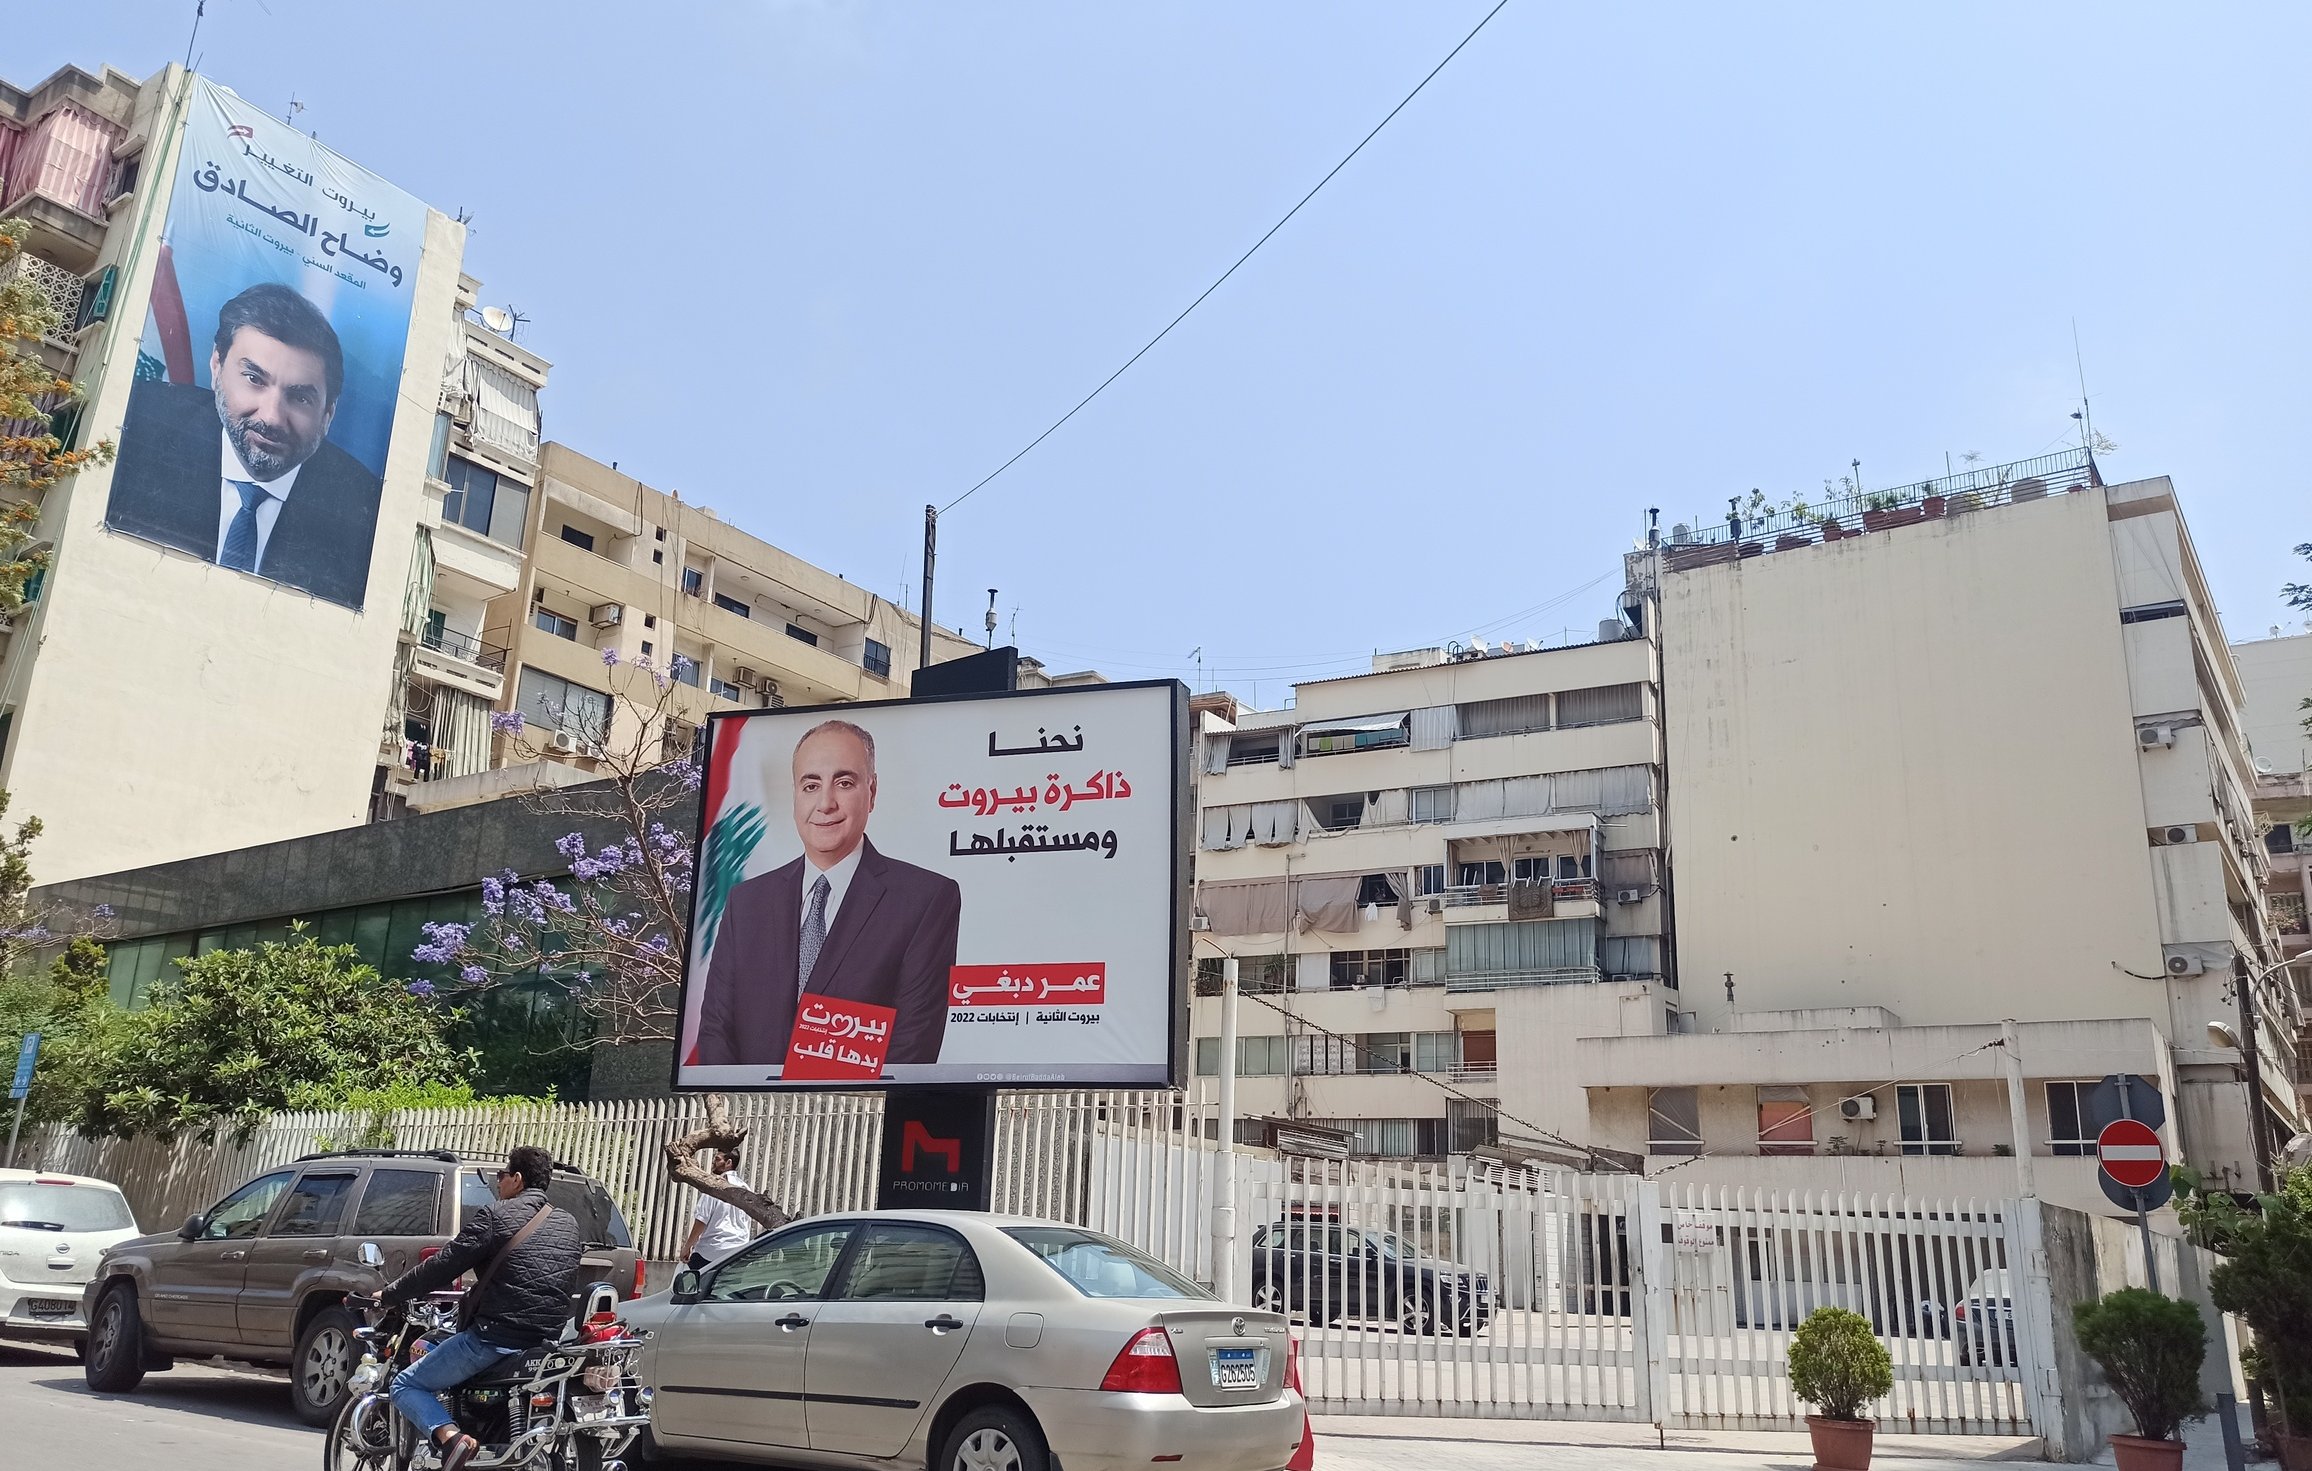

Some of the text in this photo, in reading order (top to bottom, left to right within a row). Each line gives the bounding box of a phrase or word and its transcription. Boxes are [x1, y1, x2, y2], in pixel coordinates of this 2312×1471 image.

[243, 144, 376, 221] بيروت التغيير
[193, 161, 403, 288] وضاح الصادق
[226, 214, 262, 239] الثانية
[262, 233, 294, 256] بيروت
[302, 255, 333, 274] السني
[333, 271, 367, 290] المقعد
[989, 724, 1084, 757] نحنا
[938, 769, 1132, 815] ذاكرة بيروت
[949, 824, 1118, 863] ومستقبلها
[952, 969, 1101, 1006] عمر دبغي
[802, 1003, 887, 1043] بيروت
[950, 1012, 975, 1023] 2022
[976, 1011, 1020, 1026] إنتخابات
[1035, 1009, 1067, 1025] الثانية
[1067, 1011, 1100, 1025] بيروت
[793, 1039, 879, 1074] بدها قلب
[1220, 1363, 1256, 1383] G262505
